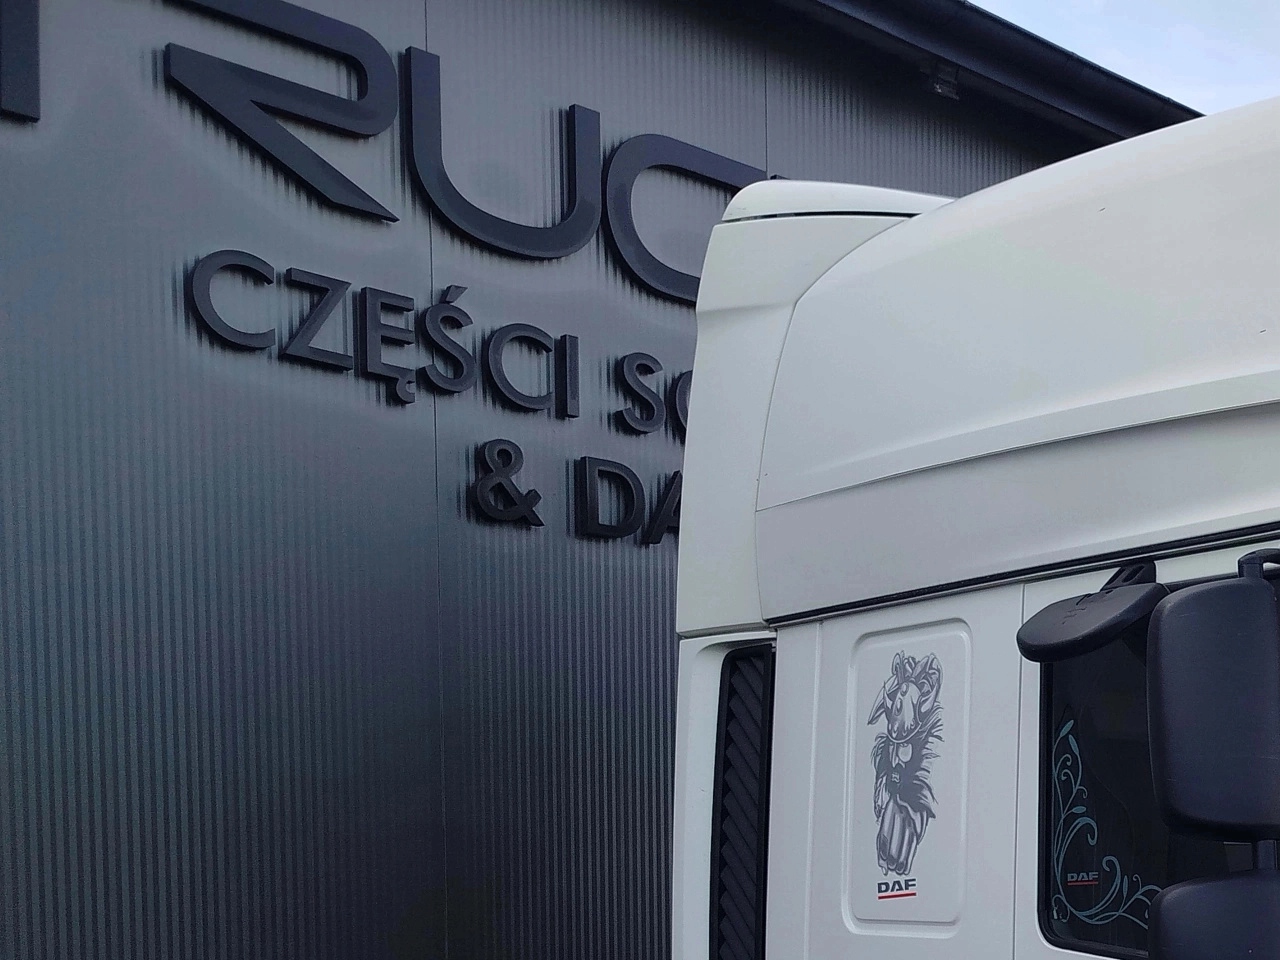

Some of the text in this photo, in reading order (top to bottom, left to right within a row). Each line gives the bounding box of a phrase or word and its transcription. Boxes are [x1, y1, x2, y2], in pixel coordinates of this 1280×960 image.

[189, 248, 580, 419] CZĘŚCI
[474, 438, 546, 528] &
[877, 878, 917, 894] DAF
[1067, 871, 1099, 883] DAF
